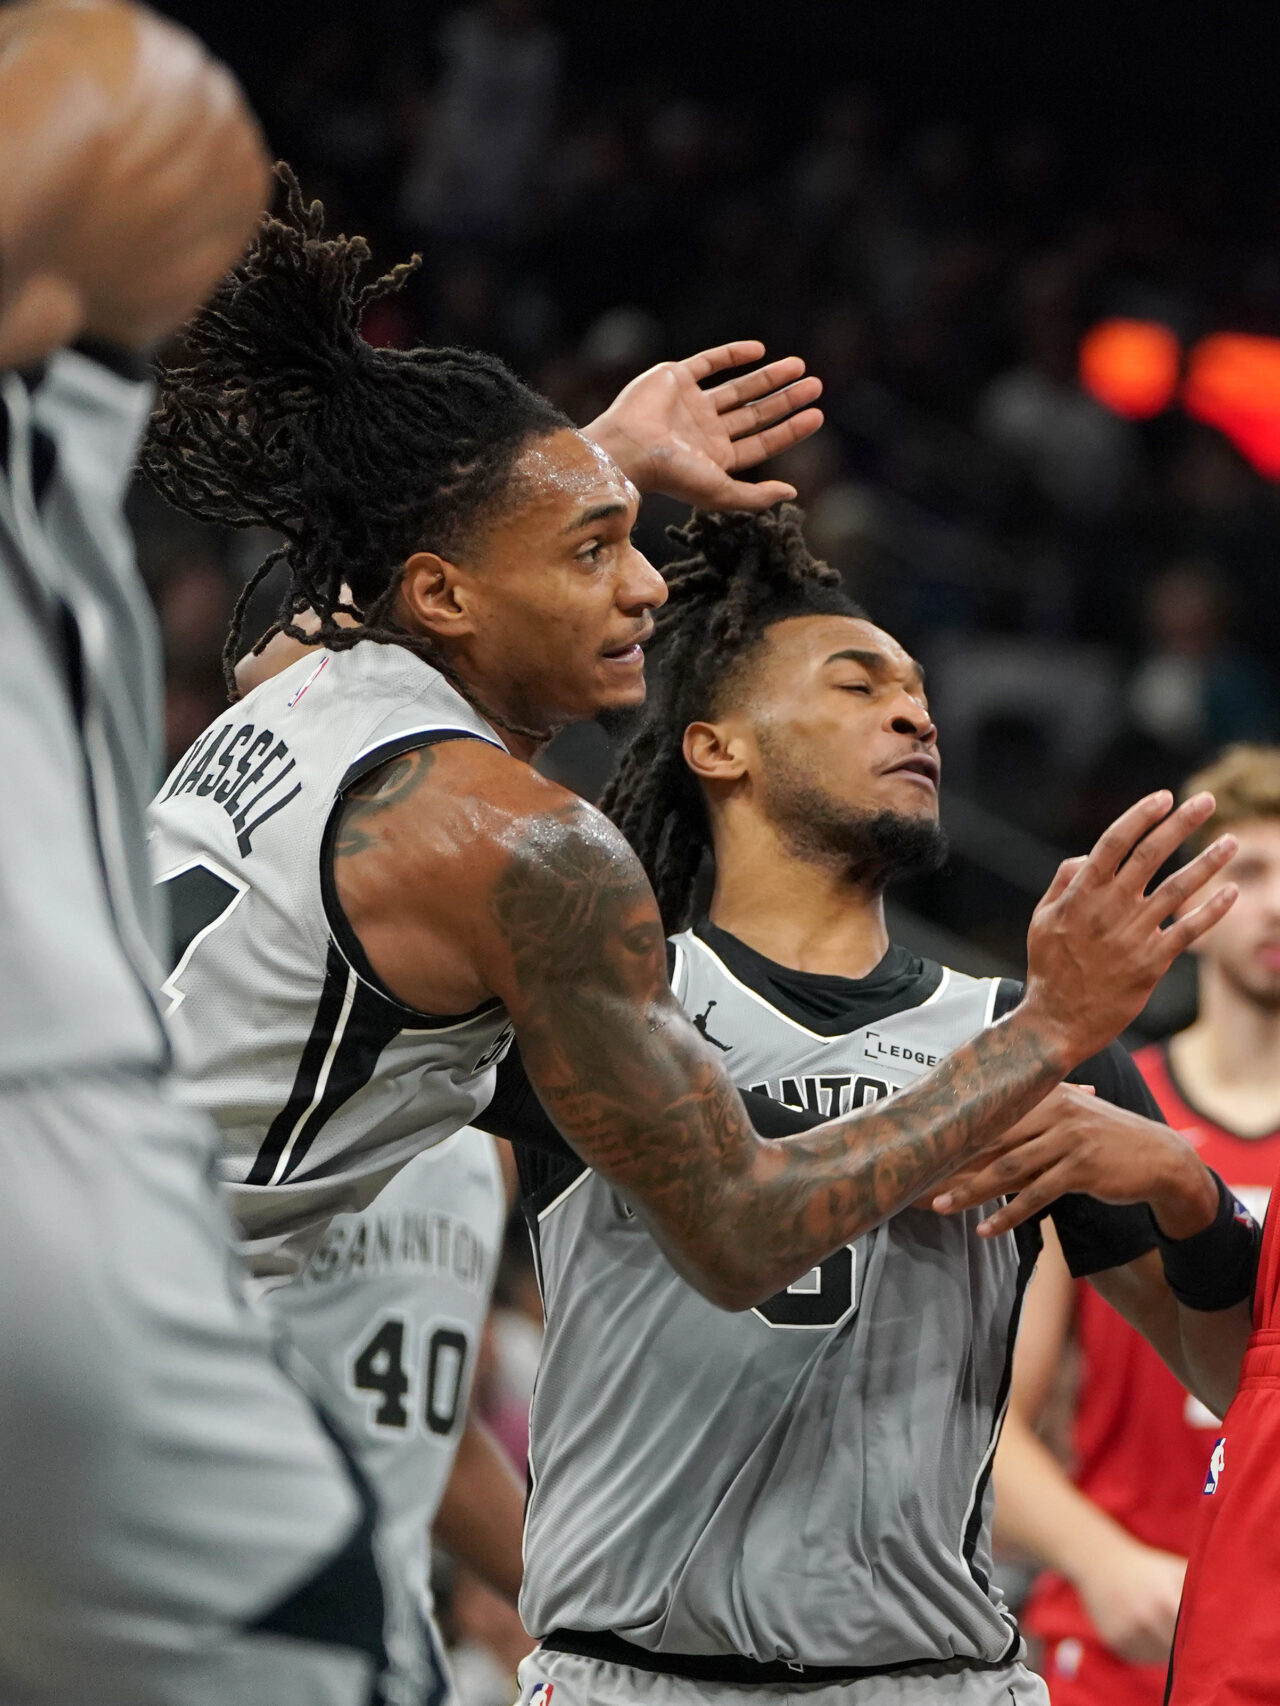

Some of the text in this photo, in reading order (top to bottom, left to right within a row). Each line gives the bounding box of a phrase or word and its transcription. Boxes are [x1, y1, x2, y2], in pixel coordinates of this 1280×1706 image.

[159, 723, 302, 860] VASSELL
[877, 1041, 942, 1068] LEDGE
[351, 1318, 469, 1437] 40
